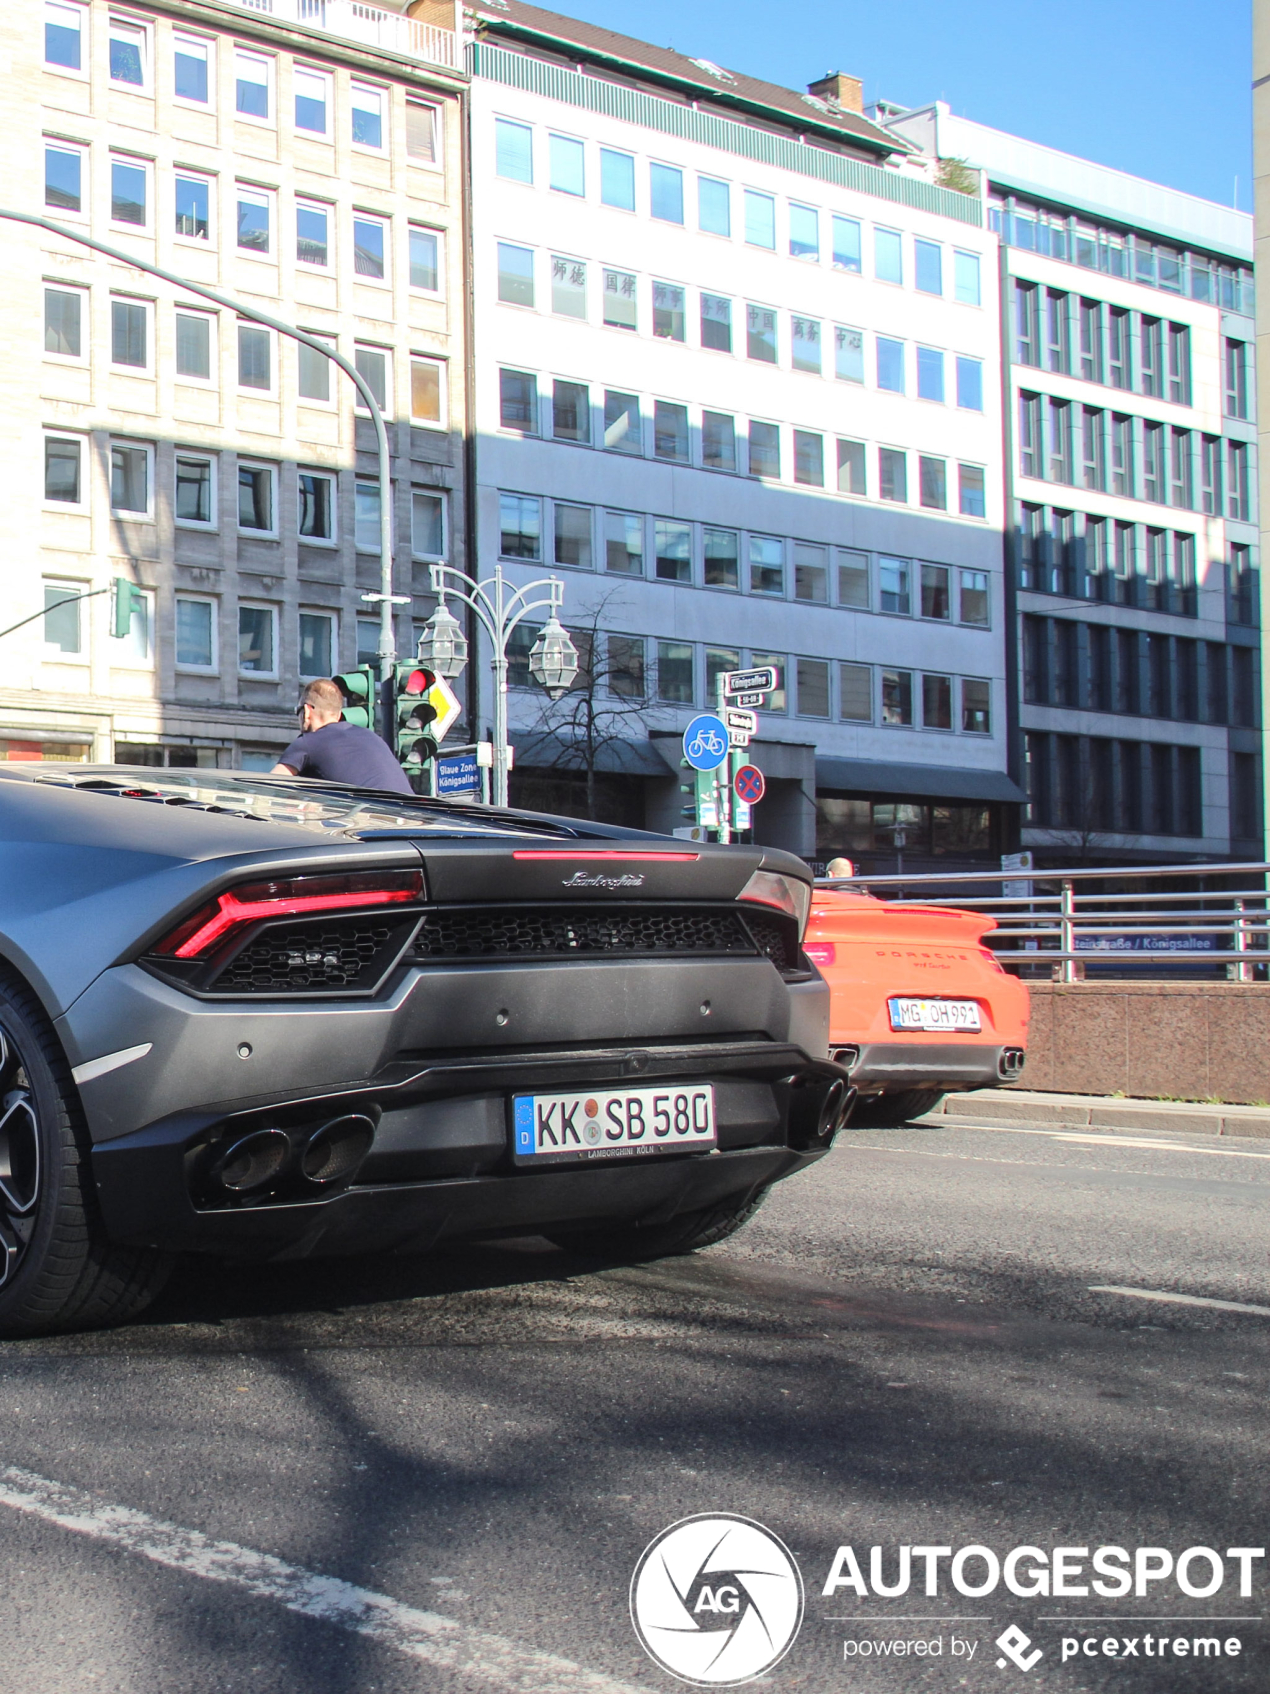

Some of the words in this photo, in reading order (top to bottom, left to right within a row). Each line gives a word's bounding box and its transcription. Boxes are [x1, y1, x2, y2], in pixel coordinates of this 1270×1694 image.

[731, 675, 767, 689] Königsallee
[439, 765, 459, 775] Blaue
[460, 763, 477, 773] Zone
[439, 774, 478, 788] Königsallee
[562, 871, 645, 890] Lamborghini
[1072, 938, 1131, 950] teinstraße
[1143, 937, 1211, 950] Königsallee
[876, 951, 968, 960] PORSCHE
[900, 1004, 921, 1023] MG
[930, 1005, 950, 1024] OH
[951, 1005, 978, 1025] 991
[537, 1101, 581, 1147] KK
[605, 1097, 645, 1140] SB
[652, 1092, 709, 1137] 580
[521, 1132, 529, 1145] D
[588, 1149, 633, 1159] LAMBORGHINI
[636, 1145, 654, 1155] KÖLN
